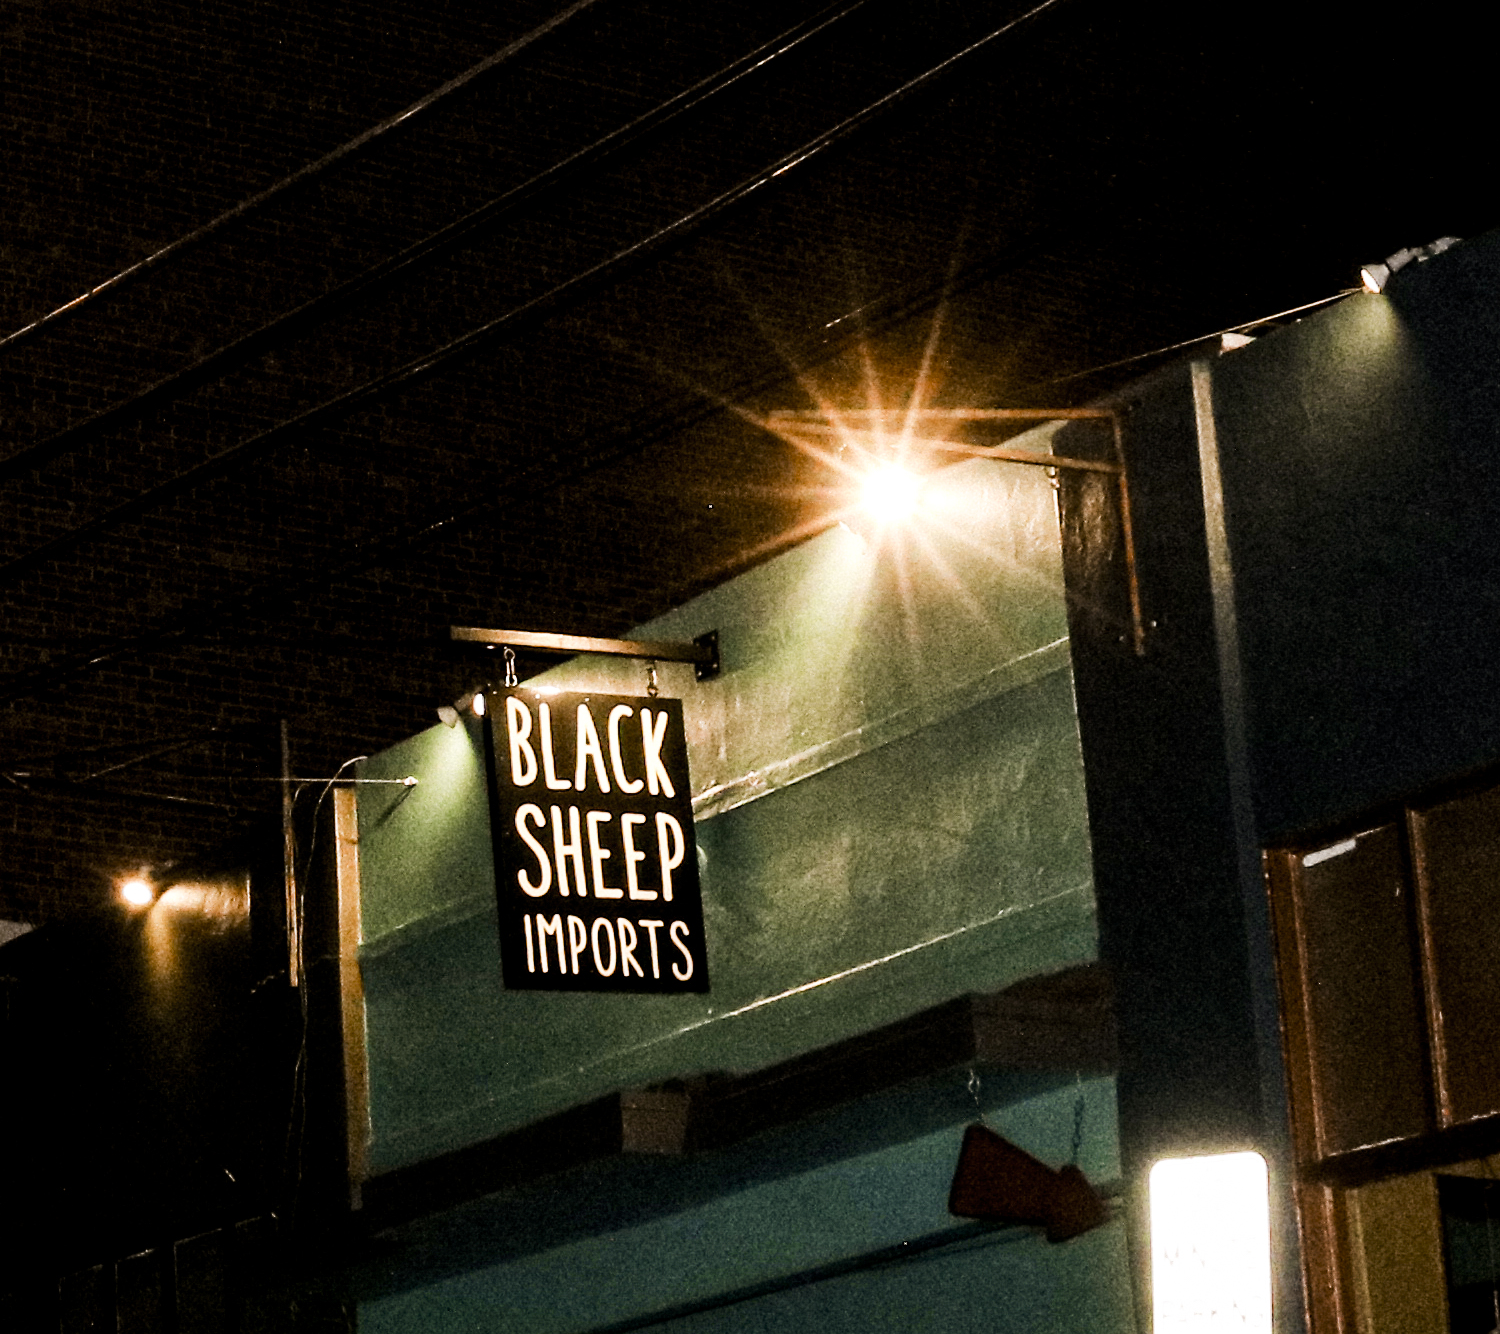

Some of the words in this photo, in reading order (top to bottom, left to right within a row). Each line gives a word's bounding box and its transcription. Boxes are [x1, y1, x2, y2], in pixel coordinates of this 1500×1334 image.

[505, 695, 677, 799] BLACK
[514, 802, 685, 902] SHEEP
[523, 913, 694, 981] IMPORTS
